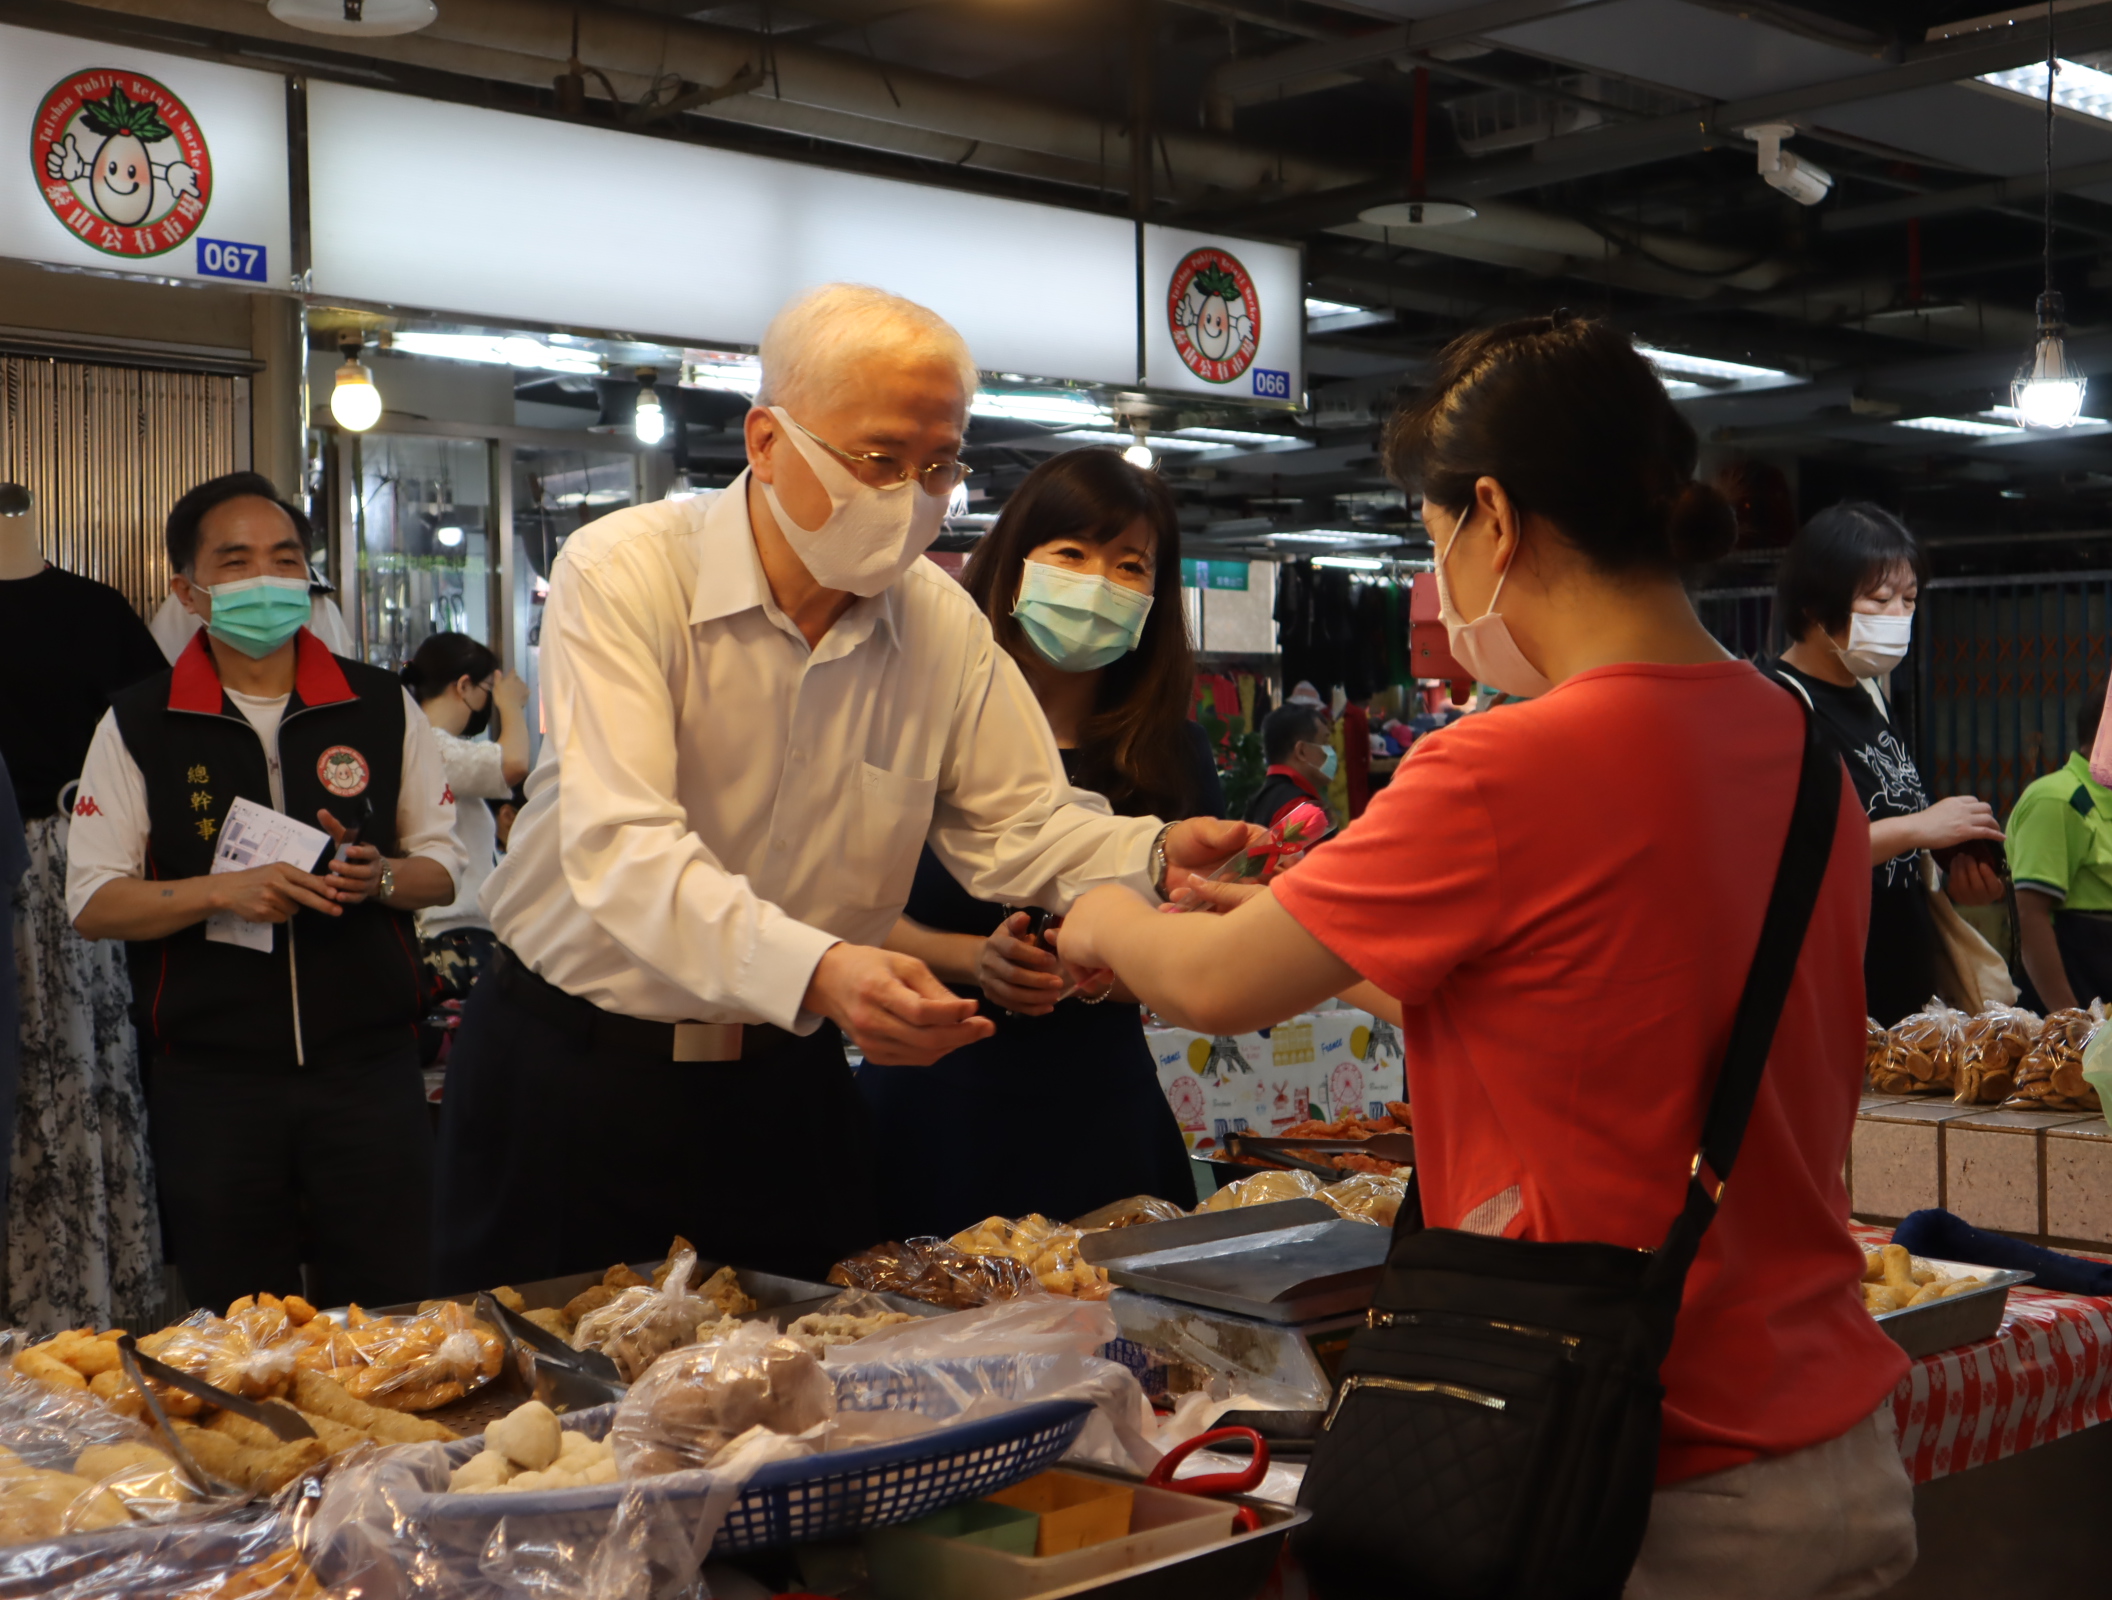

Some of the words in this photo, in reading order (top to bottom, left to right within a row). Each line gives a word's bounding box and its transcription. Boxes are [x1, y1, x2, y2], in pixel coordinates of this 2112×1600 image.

[39, 96, 74, 143] Taishan
[74, 75, 124, 96] Public
[132, 81, 180, 118] Retail
[204, 242, 259, 275] 067
[1256, 372, 1286, 395] 066
[187, 763, 217, 841] 總幹事
[1320, 1037, 1344, 1056] France
